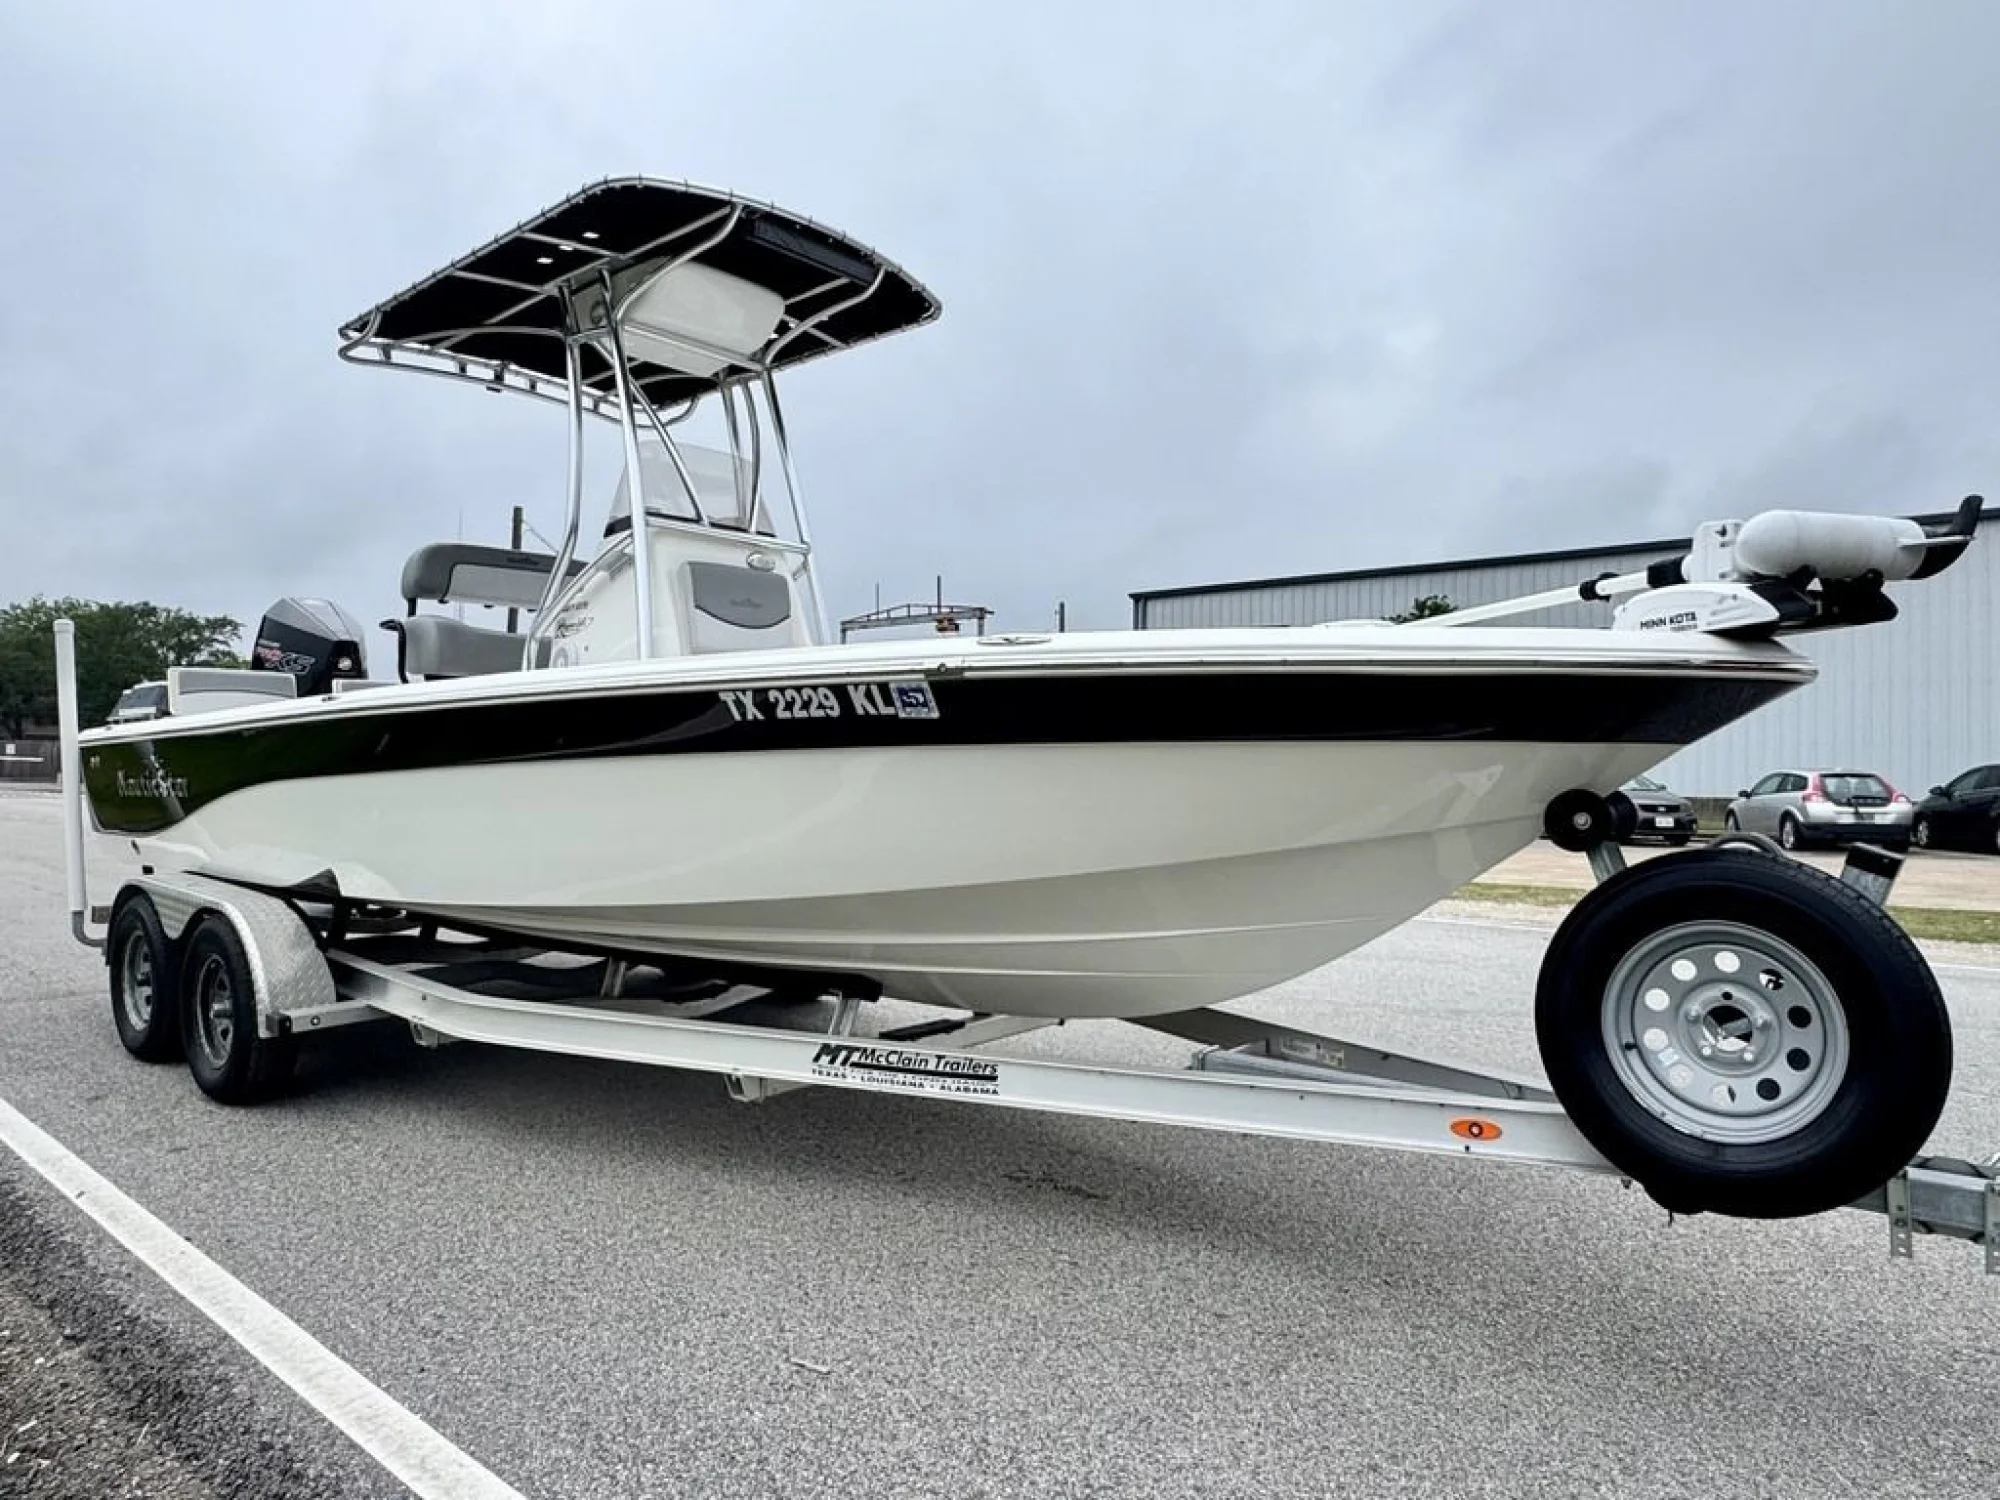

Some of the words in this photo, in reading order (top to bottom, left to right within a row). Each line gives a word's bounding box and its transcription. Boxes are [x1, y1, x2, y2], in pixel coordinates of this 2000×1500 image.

[1669, 610, 1698, 625] KOTA
[719, 690, 765, 721] TX
[768, 687, 841, 719] 2229
[847, 684, 896, 716] KL
[858, 1048, 929, 1069] McClain
[934, 1054, 999, 1074] Trailers
